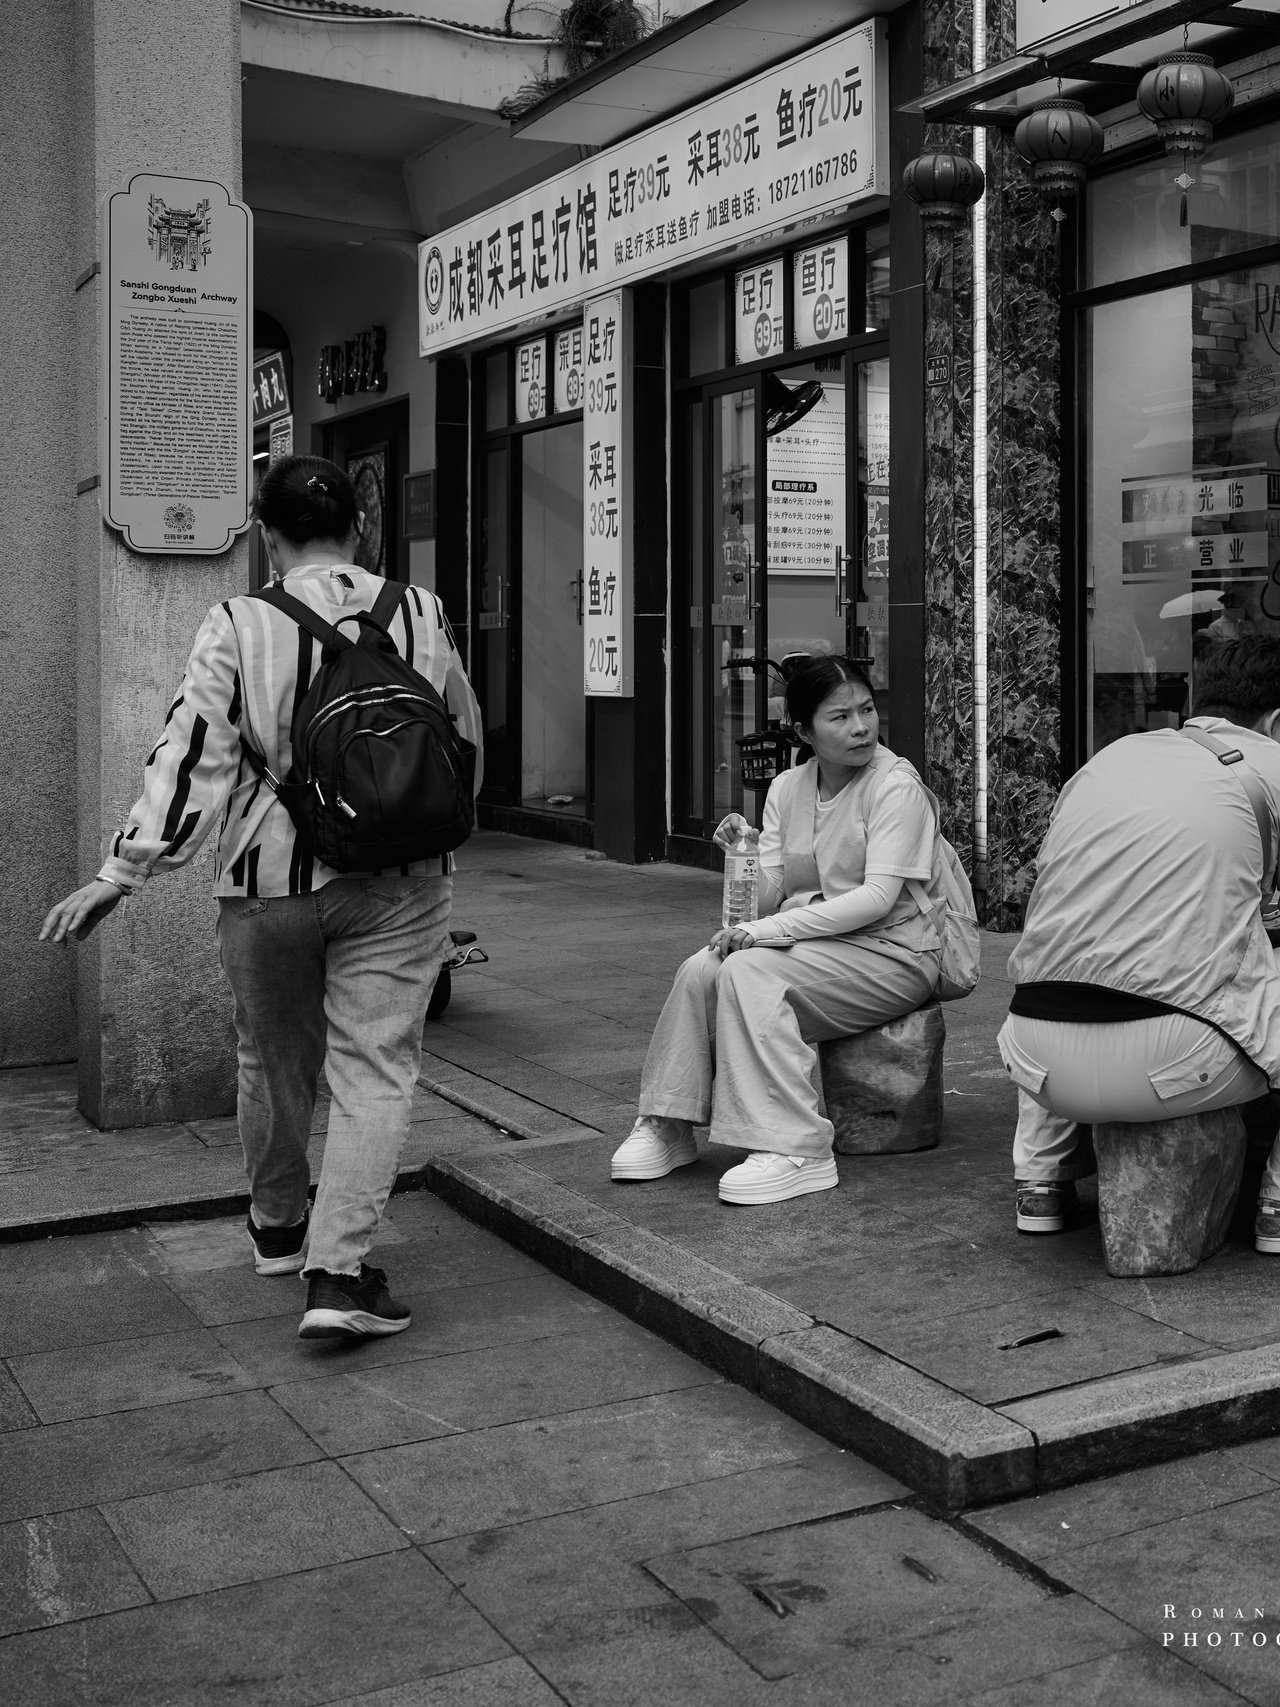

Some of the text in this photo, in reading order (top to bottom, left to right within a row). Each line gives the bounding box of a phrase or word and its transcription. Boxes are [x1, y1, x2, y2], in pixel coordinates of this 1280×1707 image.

[607, 66, 862, 221] 足疗39元 采耳38元 鱼疗20元
[449, 183, 598, 323] 成都采耳足疗馆
[614, 210, 700, 267] 做足疗采耳送鱼疗
[120, 280, 197, 293] Sanshi Gongduan
[742, 269, 772, 316] 足疗
[802, 247, 836, 296] 鱼疗
[132, 292, 237, 304] Zongbo Xueshi Archway
[816, 299, 846, 331] 20元
[587, 317, 616, 366] 足疗
[756, 316, 783, 347] 39元
[589, 372, 617, 414] 39元
[589, 441, 616, 490] 采耳
[590, 497, 618, 539] 38元
[1143, 482, 1243, 518] 光临
[1143, 538, 1244, 568] 正营业
[588, 566, 616, 616] 鱼疗
[589, 635, 618, 676] 20元
